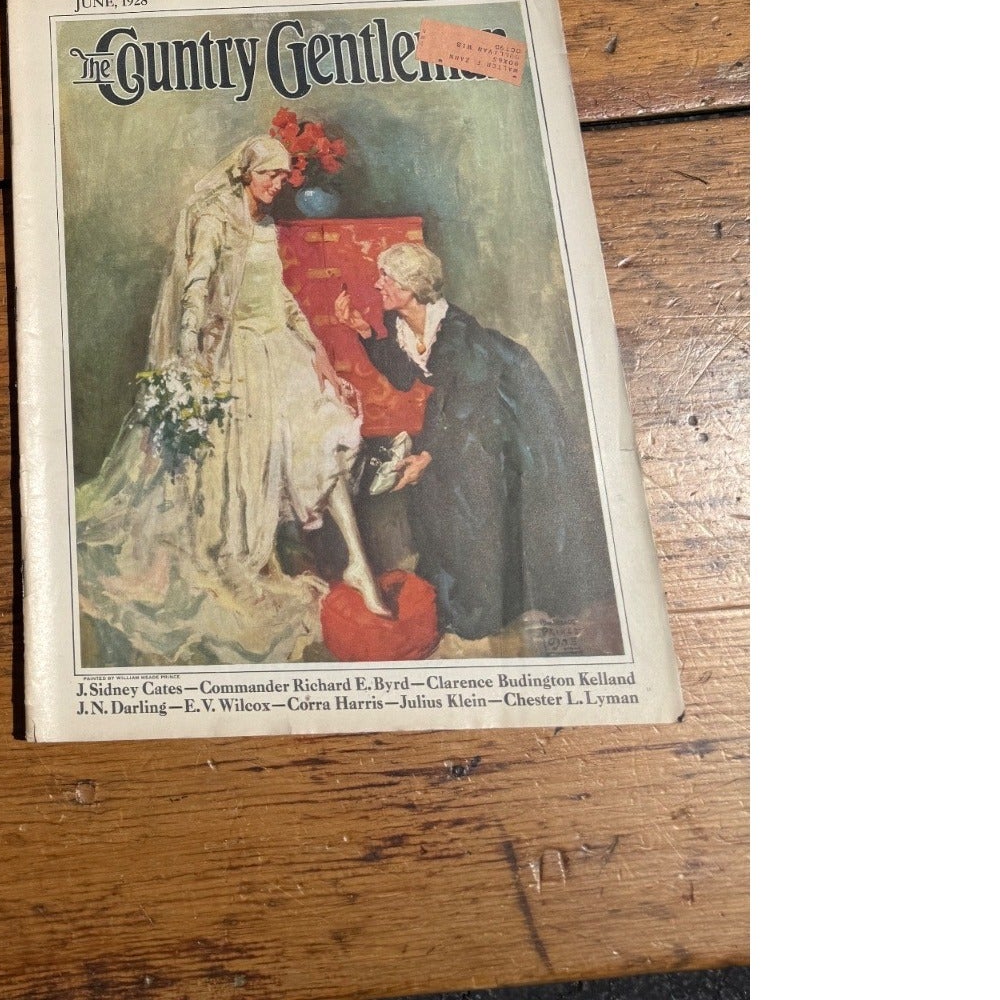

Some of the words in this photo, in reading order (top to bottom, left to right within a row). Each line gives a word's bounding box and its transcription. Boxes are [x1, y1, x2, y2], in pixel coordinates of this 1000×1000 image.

[70, 48, 113, 85] The
[96, 27, 260, 106] Country
[266, 19, 507, 99] Gentle
[89, 681, 138, 699] Sidney
[292, 677, 352, 692] Richard
[354, 676, 371, 691] E.
[497, 673, 574, 691] Budington
[578, 671, 636, 686] Kelland
[566, 691, 583, 705] L.
[585, 690, 639, 708] Lyman
